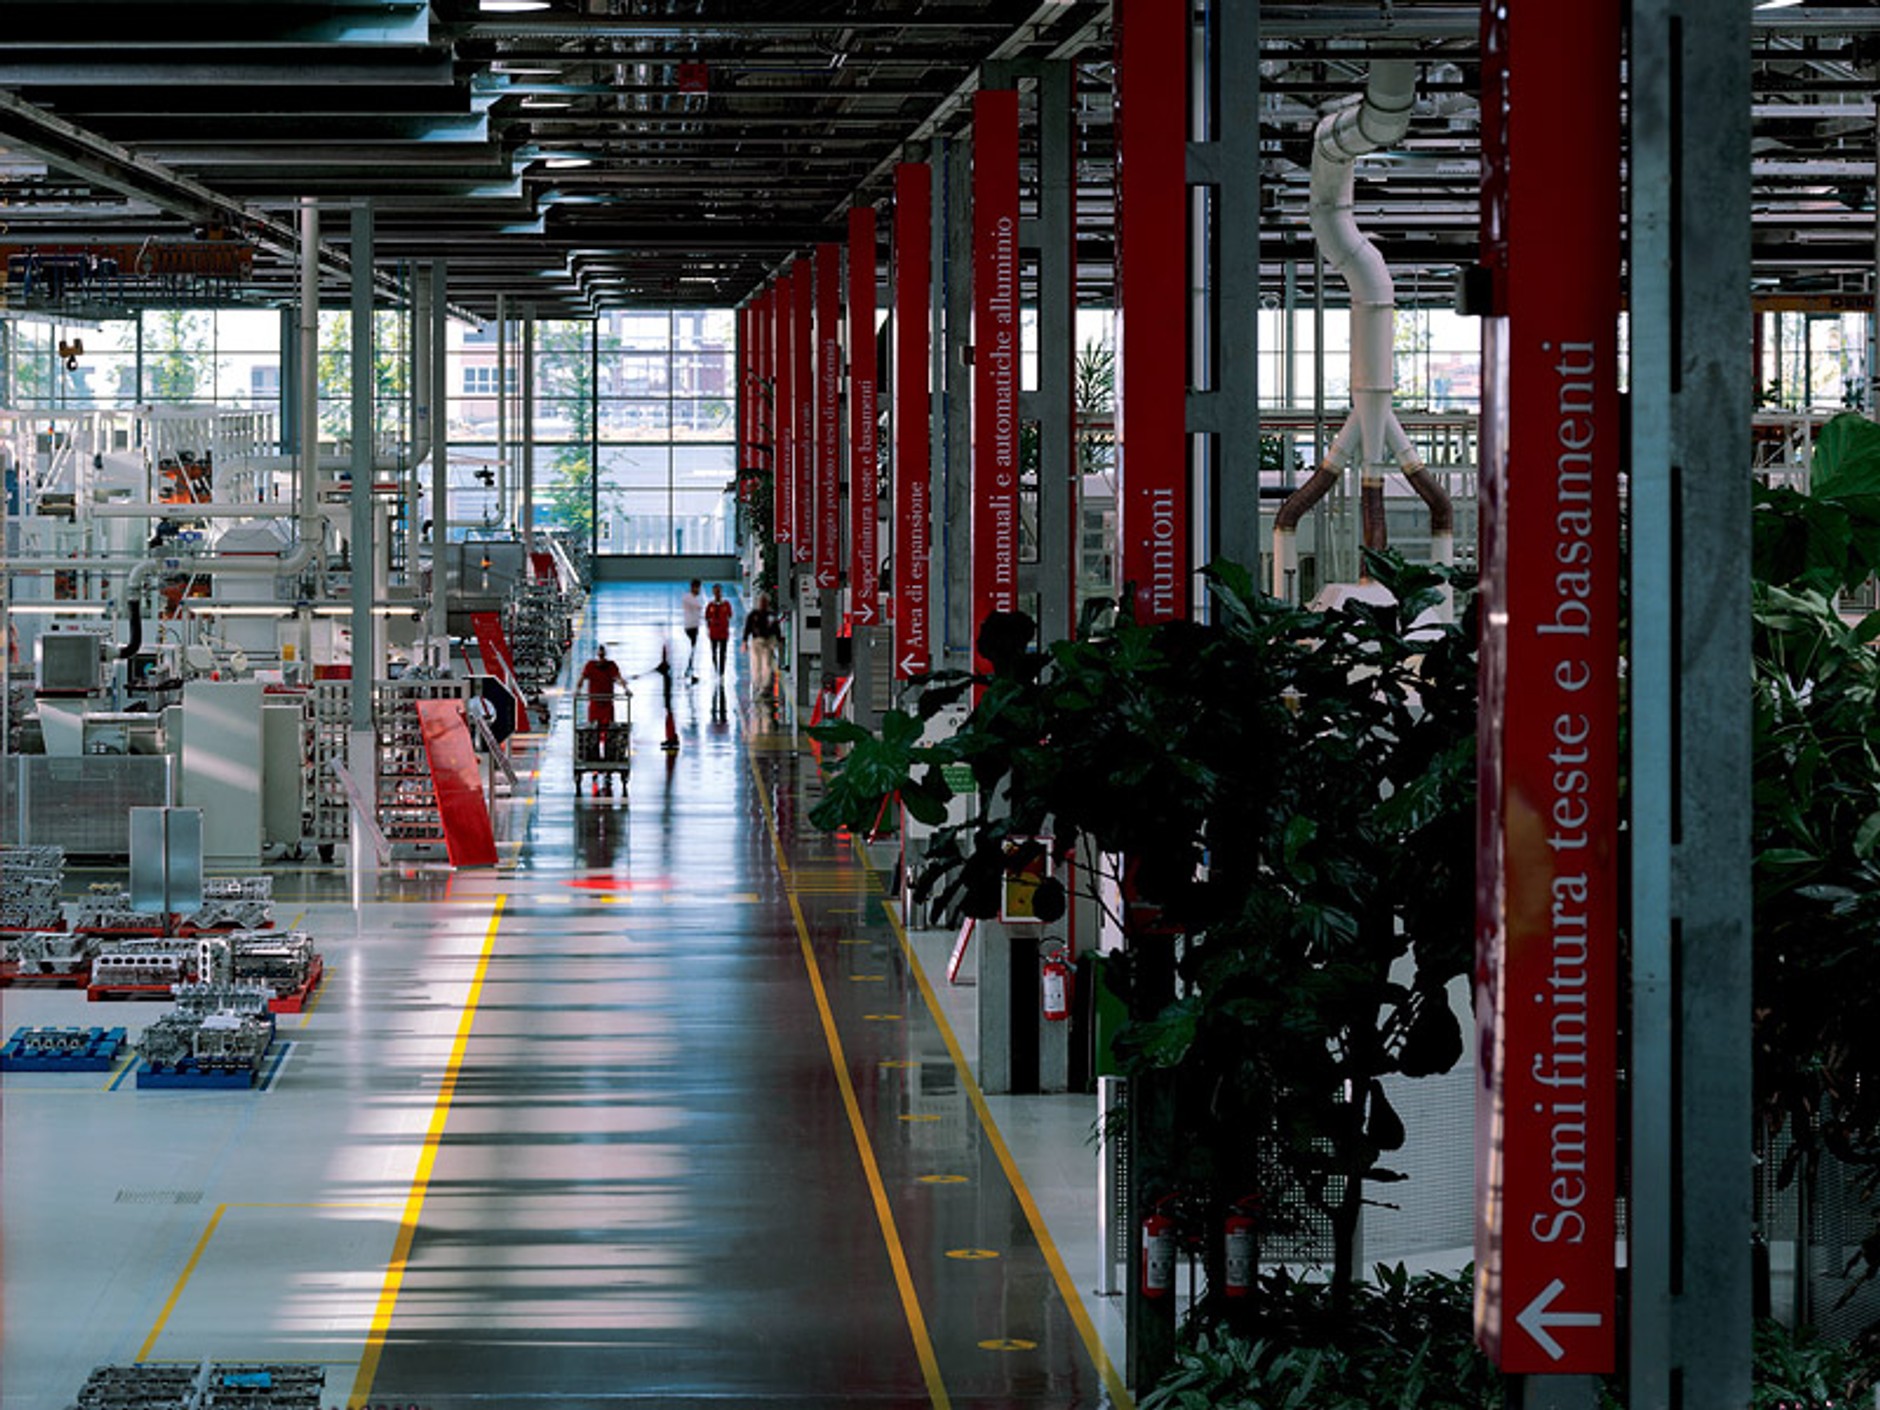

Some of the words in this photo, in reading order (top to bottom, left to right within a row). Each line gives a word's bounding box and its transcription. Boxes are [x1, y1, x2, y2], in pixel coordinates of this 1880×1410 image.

[989, 217, 1011, 324] alluminio
[822, 407, 835, 419] di
[857, 381, 873, 452] basamenti
[989, 331, 1011, 467] automatiche
[862, 456, 873, 464] e
[862, 468, 873, 502] teste
[996, 473, 1011, 488] e
[1536, 341, 1594, 636] basamenti
[822, 512, 838, 565] Lavaggio
[858, 507, 878, 598] Superfinitura
[905, 482, 928, 580] espansione
[989, 496, 1011, 583] manuali
[1142, 488, 1173, 615] riunioni
[905, 584, 923, 603] di
[906, 607, 923, 648] Area
[1555, 660, 1590, 691] e
[1548, 713, 1589, 851] teste
